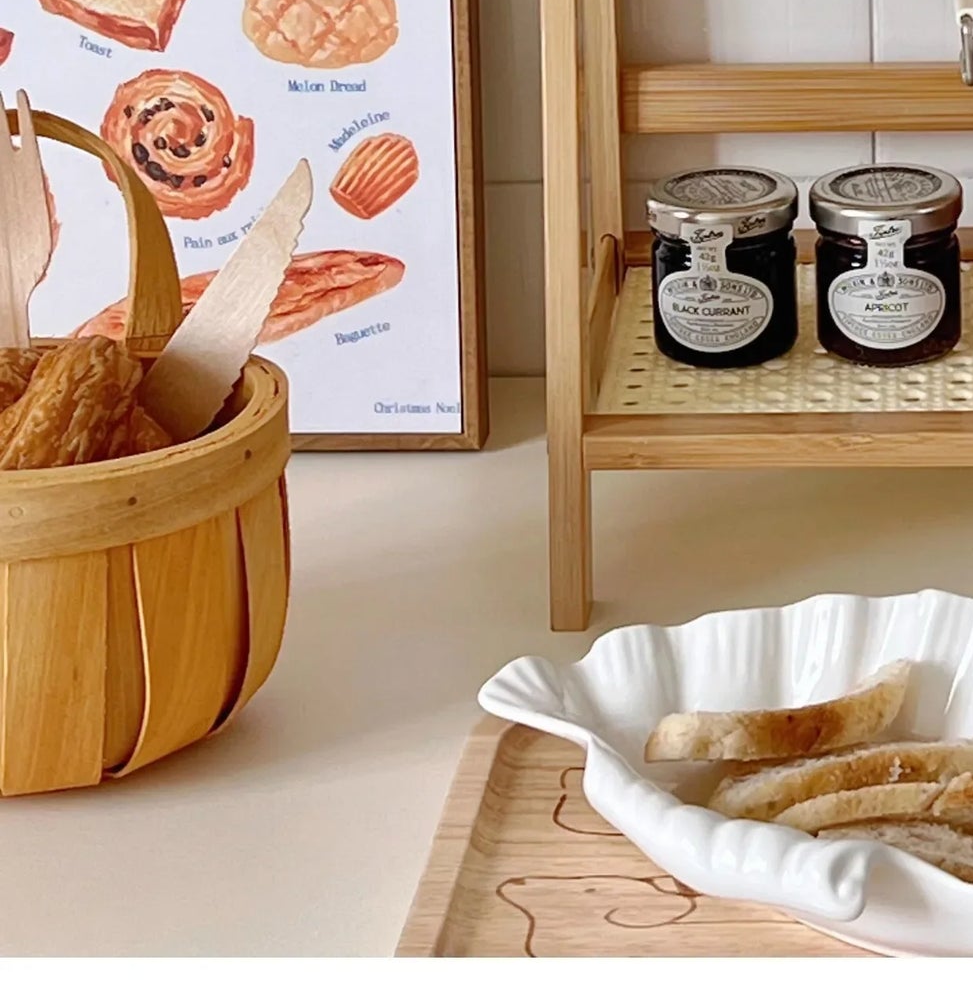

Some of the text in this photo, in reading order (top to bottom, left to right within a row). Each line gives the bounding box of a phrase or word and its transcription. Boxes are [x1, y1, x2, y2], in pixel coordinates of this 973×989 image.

[79, 35, 113, 59] Toast
[288, 79, 324, 92] Melon
[328, 111, 390, 152] Madeleine
[184, 236, 213, 249] Pain
[672, 302, 751, 317] BLACK CURRANT
[864, 302, 909, 313] APRICOT
[334, 322, 391, 345] Baguette
[373, 402, 431, 414] Christmas
